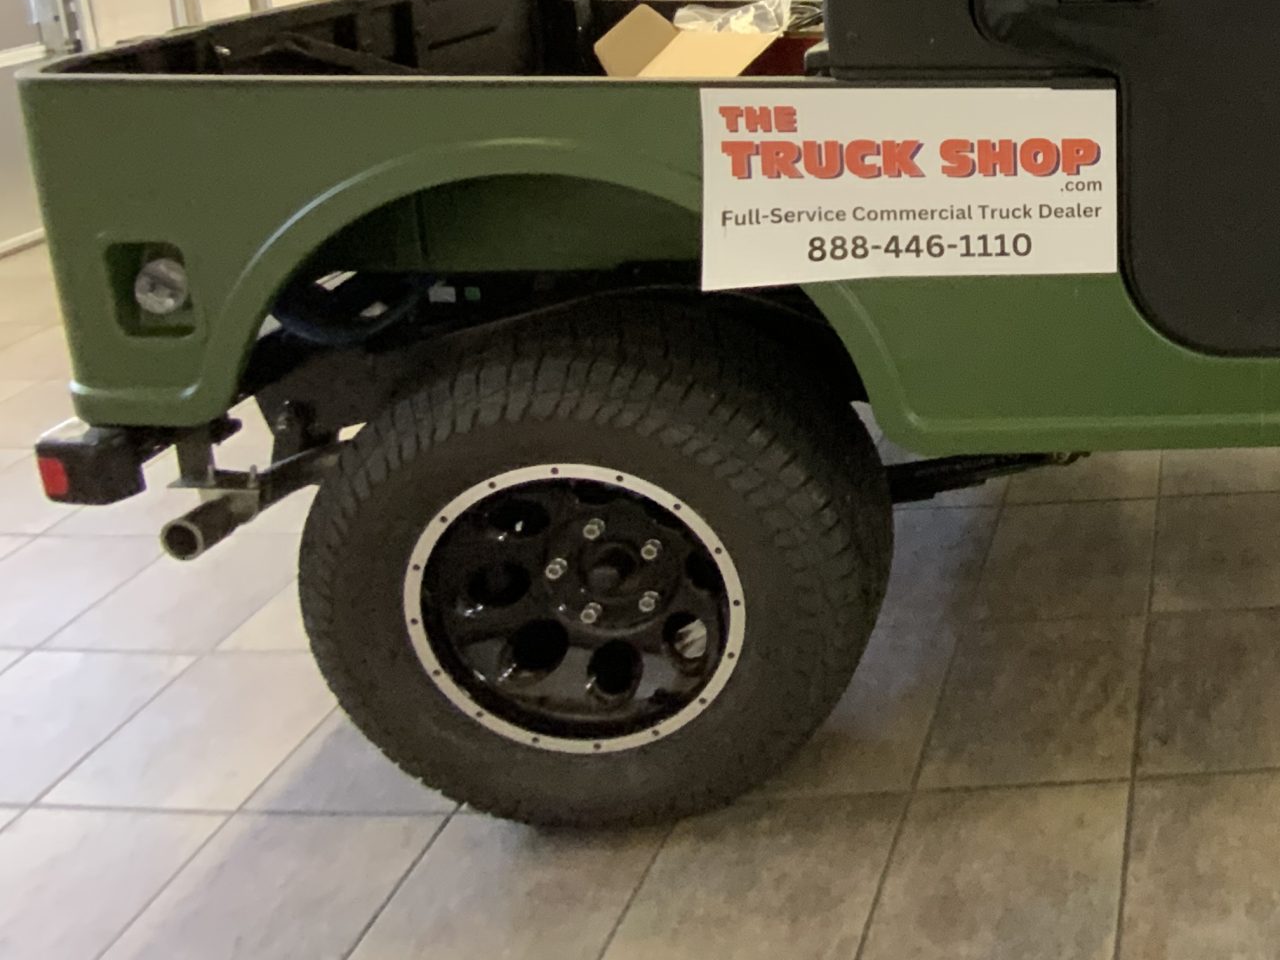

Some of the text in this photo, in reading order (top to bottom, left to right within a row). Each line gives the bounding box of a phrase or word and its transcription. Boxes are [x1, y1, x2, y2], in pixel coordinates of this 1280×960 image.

[718, 106, 798, 133] THE
[721, 137, 1101, 179] TRUCK SHOP
[1060, 179, 1102, 193] .com
[722, 203, 1102, 227] Full-Service Commercial Truck Dealer
[808, 233, 1032, 262] 888-446-1110
